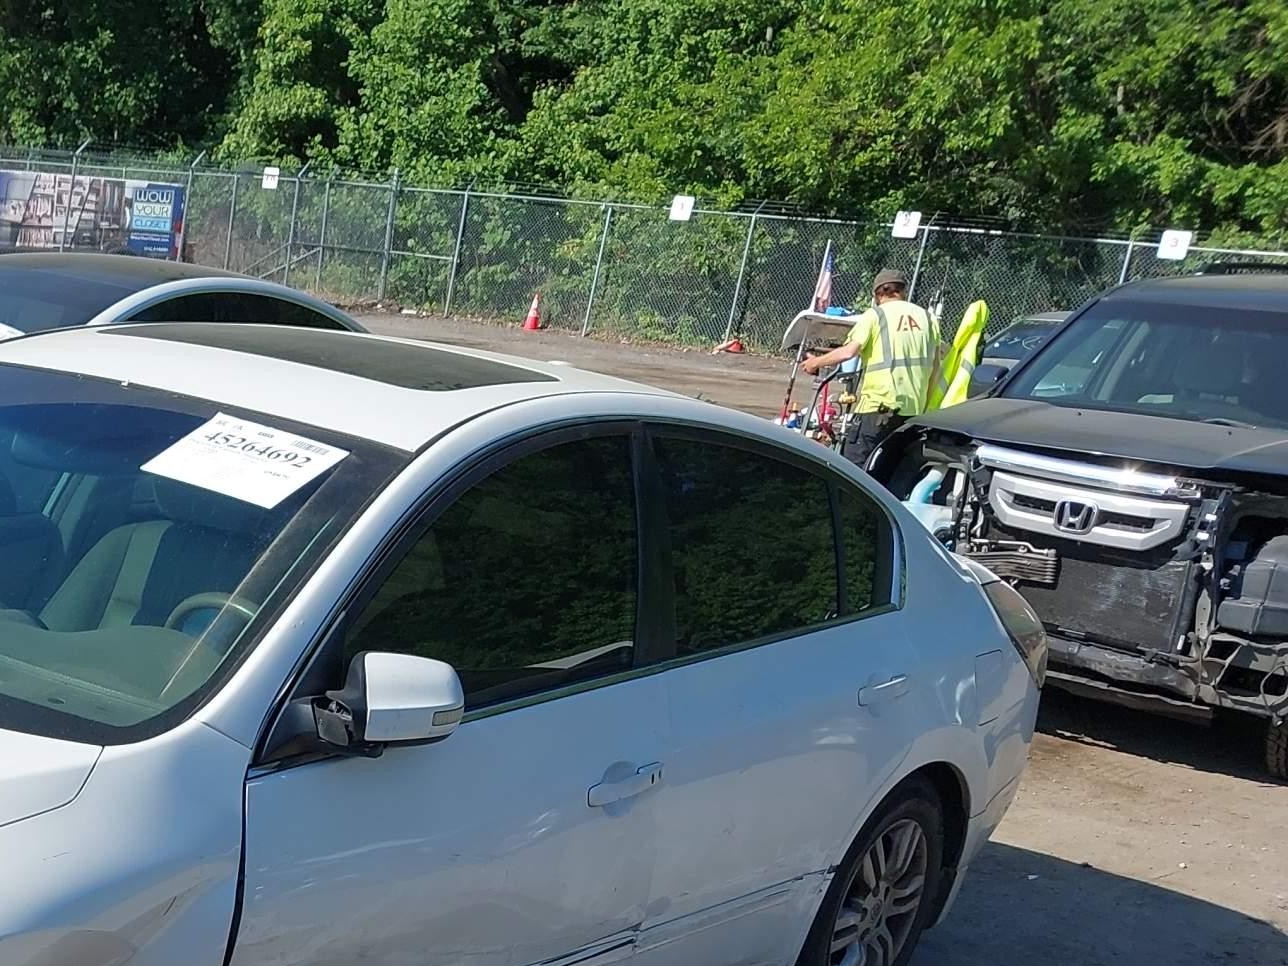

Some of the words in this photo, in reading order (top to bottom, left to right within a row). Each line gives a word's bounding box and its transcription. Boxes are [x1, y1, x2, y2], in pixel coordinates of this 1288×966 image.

[135, 190, 172, 203] WOW
[135, 204, 169, 217] YOUR
[1169, 238, 1179, 248] 3
[205, 431, 312, 468] 45264692
